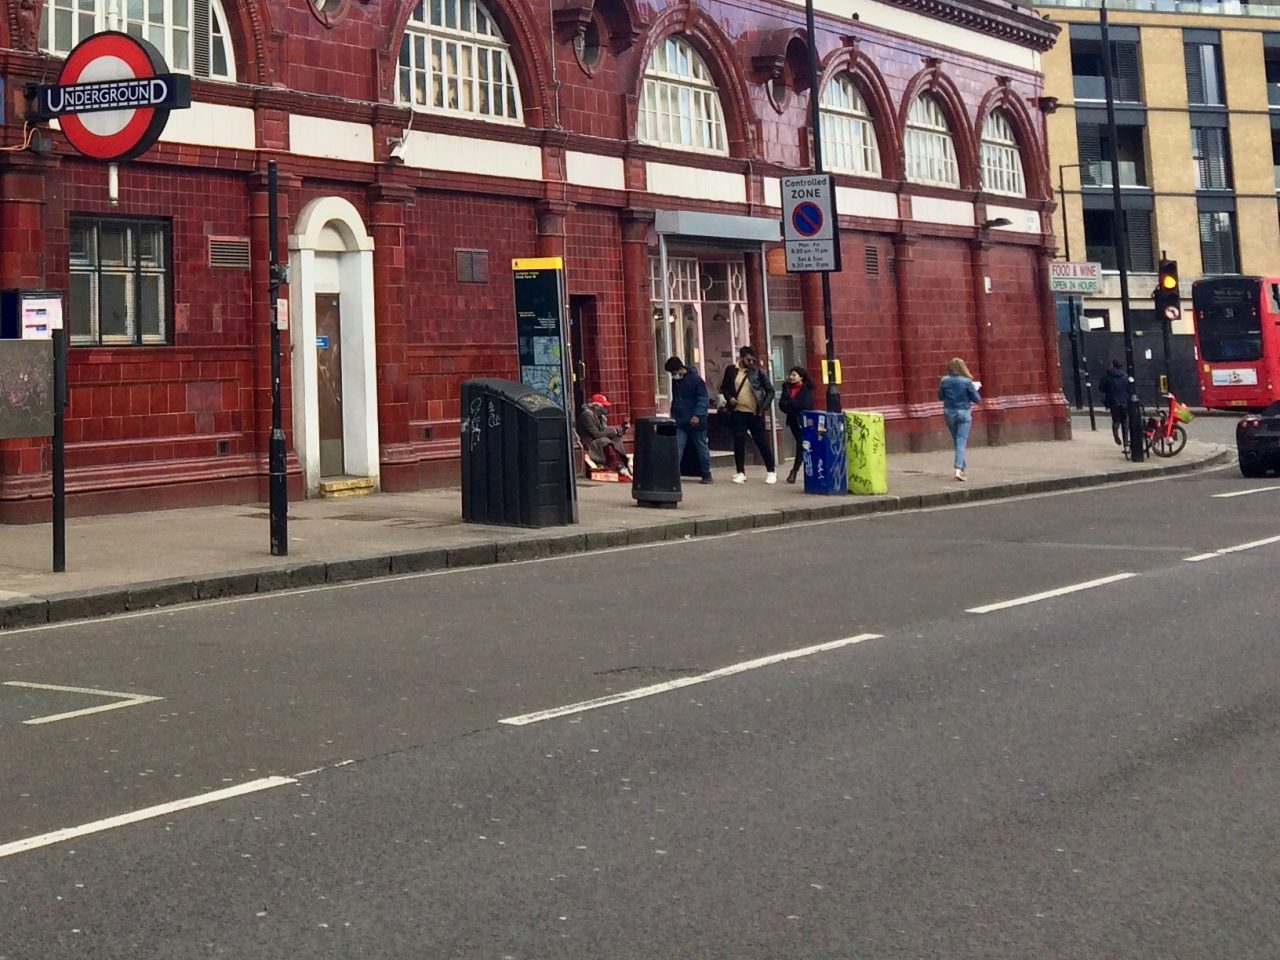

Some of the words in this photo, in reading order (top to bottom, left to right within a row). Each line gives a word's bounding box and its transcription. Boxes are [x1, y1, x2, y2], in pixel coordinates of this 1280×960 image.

[47, 79, 168, 112] UNDERGROUND
[785, 178, 827, 187] Controlled
[791, 189, 821, 199] ZONE
[1052, 264, 1070, 277] FOOD
[1072, 265, 1077, 277] &
[1080, 265, 1096, 277] WINE
[1052, 280, 1067, 290] OPEN
[1069, 281, 1076, 290] 24
[1078, 281, 1097, 290] HOURS
[1224, 307, 1234, 318] 31
